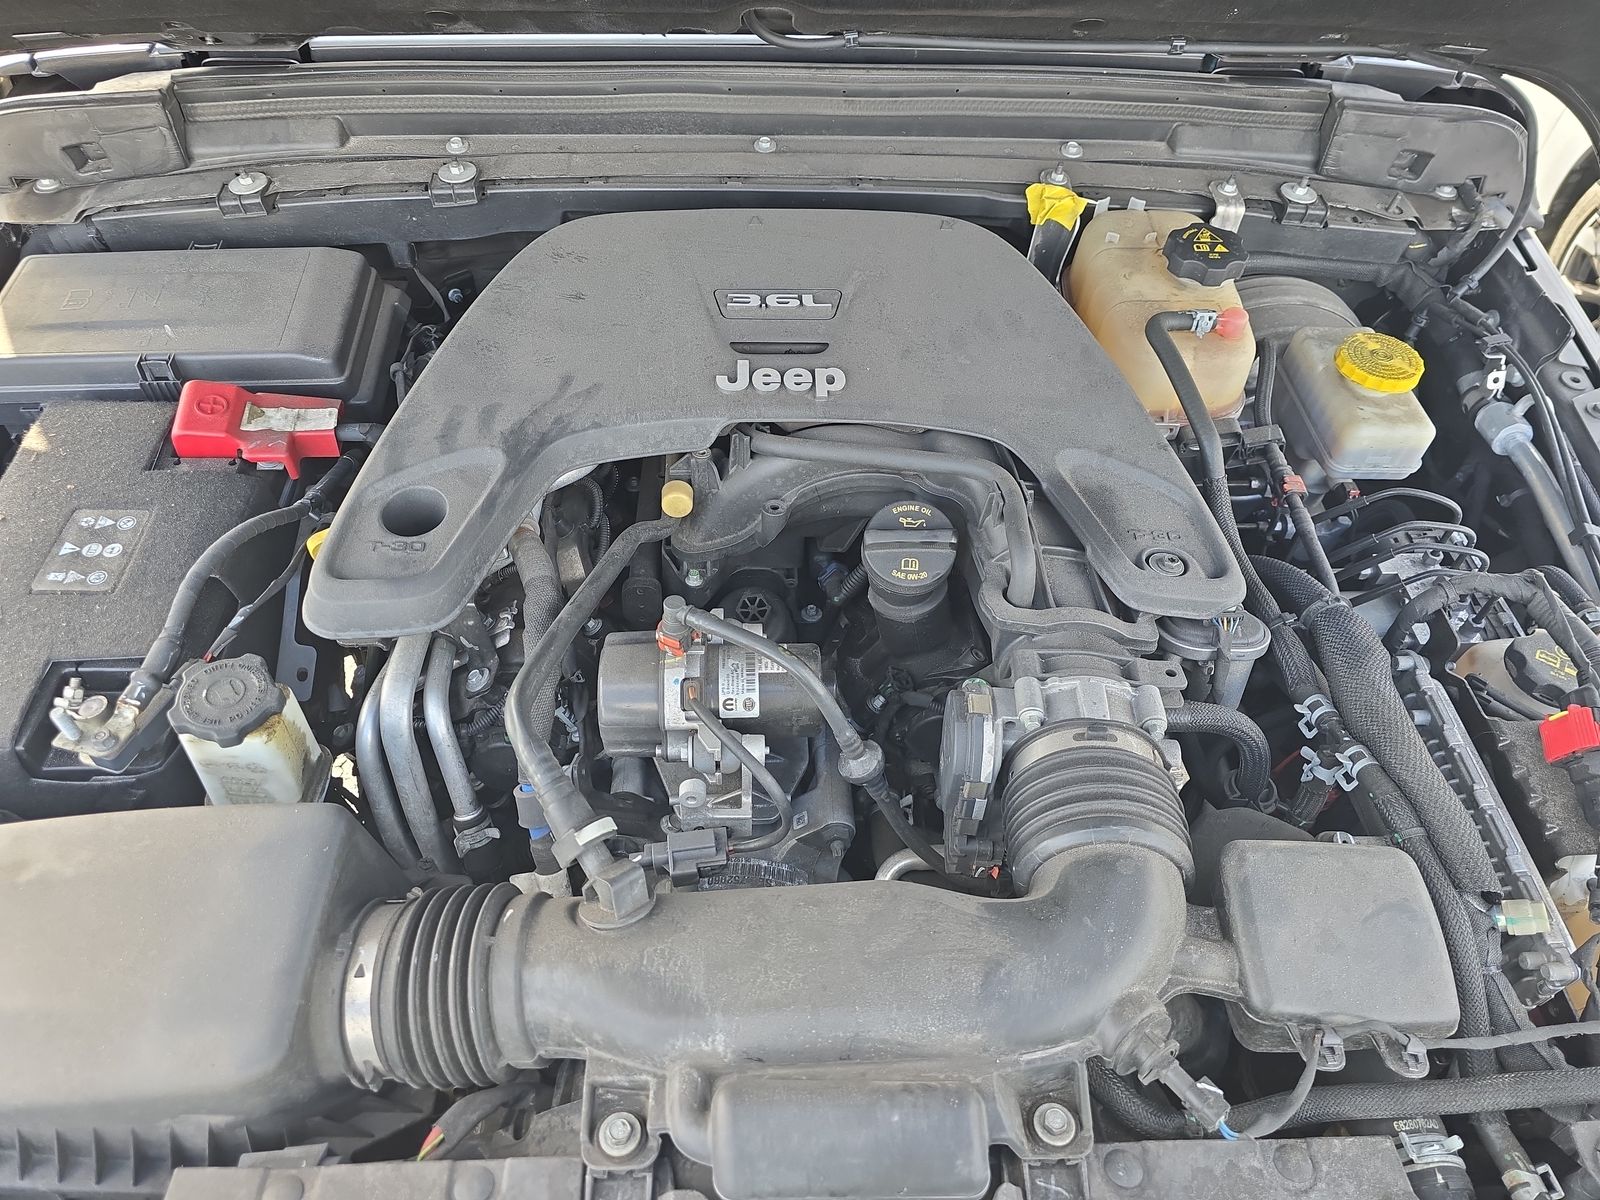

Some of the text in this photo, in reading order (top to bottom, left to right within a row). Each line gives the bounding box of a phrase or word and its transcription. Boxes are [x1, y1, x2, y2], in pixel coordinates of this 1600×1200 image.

[726, 293, 832, 309] 3.6L
[715, 359, 846, 399] Jeep
[892, 504, 932, 517] ENGINE OIL
[891, 569, 928, 580] SAE 0W-20
